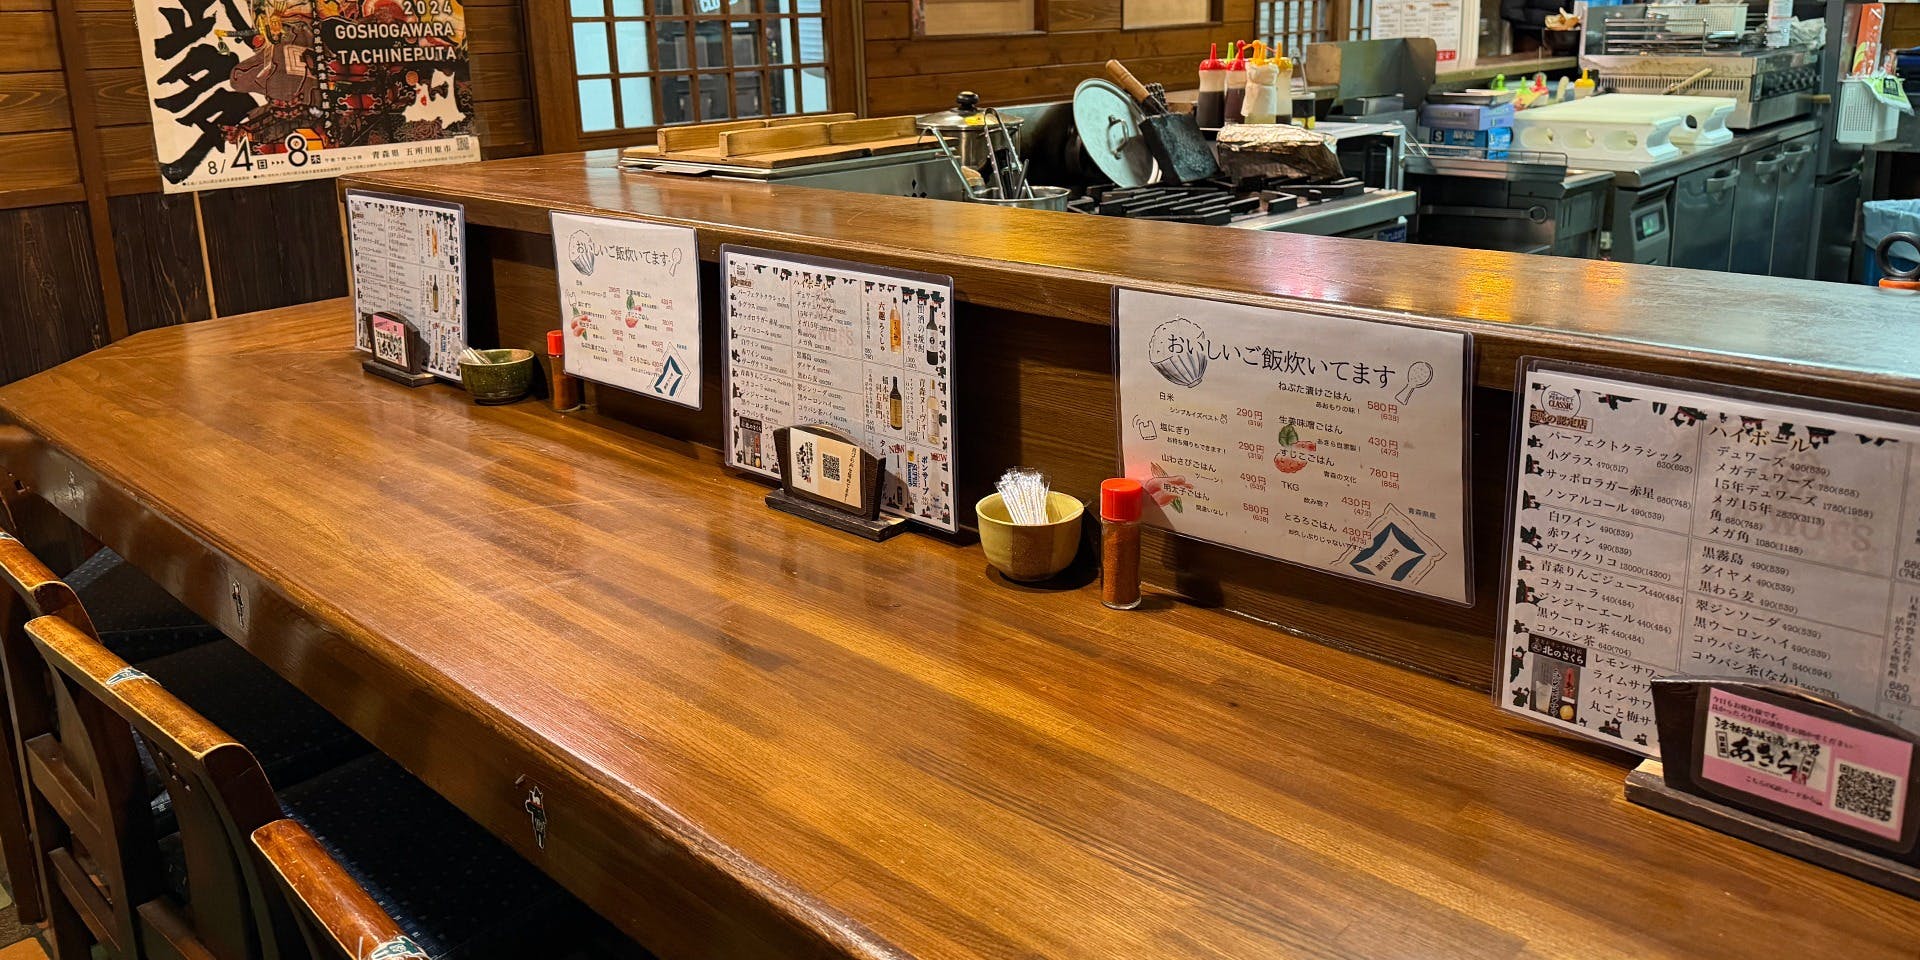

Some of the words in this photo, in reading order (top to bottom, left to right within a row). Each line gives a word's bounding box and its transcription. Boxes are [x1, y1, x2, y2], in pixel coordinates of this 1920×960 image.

[403, 1, 453, 15] 2024
[335, 22, 455, 39] GOSHOGAWARA
[337, 46, 457, 65] TACHINEPUTA
[372, 148, 401, 160] 青森県
[576, 242, 669, 266] おいしいご飯炊いてます
[1168, 333, 1396, 389] おいしいご飯炊いてます
[1159, 391, 1175, 402] 白米
[1278, 381, 1352, 402] ねぶた漬けごはん
[1236, 407, 1263, 421] 290円
[1367, 400, 1398, 415] 580円
[1548, 400, 1574, 411] CLASSIC
[1160, 422, 1190, 436] 塩にぎり
[1709, 426, 1811, 453] ハイボール
[1238, 441, 1265, 455] 290円
[1368, 436, 1398, 451] 430円
[1549, 432, 1683, 463] パーフェクトクラシック
[1161, 453, 1217, 473] 山わさびごはん
[1279, 449, 1335, 467] すじこごはん
[1369, 467, 1399, 482] 780円
[1546, 450, 1593, 467] 小グラス
[1717, 446, 1785, 468] デュワーズ
[1240, 472, 1267, 485] 490円
[1323, 470, 1357, 484] 青森の文化
[1546, 468, 1655, 500] サッポロラガー赤星
[1715, 462, 1813, 489] メガデュワーズ
[1280, 480, 1300, 492] TKG
[1341, 496, 1371, 510] 430円
[1545, 488, 1629, 513] ノンアルコール
[1714, 477, 1817, 507] 15年デュワーズ
[1242, 503, 1269, 516] 580円
[1710, 508, 1722, 523] 角
[1712, 494, 1772, 516] メガ15年
[1284, 512, 1338, 534] とろろごはん
[1342, 526, 1372, 540] 430円
[1549, 510, 1596, 529] 白ワイン
[1547, 526, 1595, 545] 赤ワイン
[1709, 526, 1750, 544] メガ角
[1546, 542, 1617, 568] ヴーヴクリコ
[1702, 545, 1744, 566] 黒霧島
[1540, 559, 1648, 594] 青森りんごジュース
[1700, 563, 1752, 583] ダイヤメ
[1540, 576, 1600, 598] コカコーラ
[1535, 590, 1636, 624] ジンジャーエール
[1536, 606, 1610, 635] 黒ウーロン茶
[1693, 615, 1789, 650] 黒ウーロンハイ
[1542, 645, 1584, 665] 北のさくら
[1588, 700, 1657, 725] 丸ごと梅サ
[1730, 736, 1798, 775] あきら
